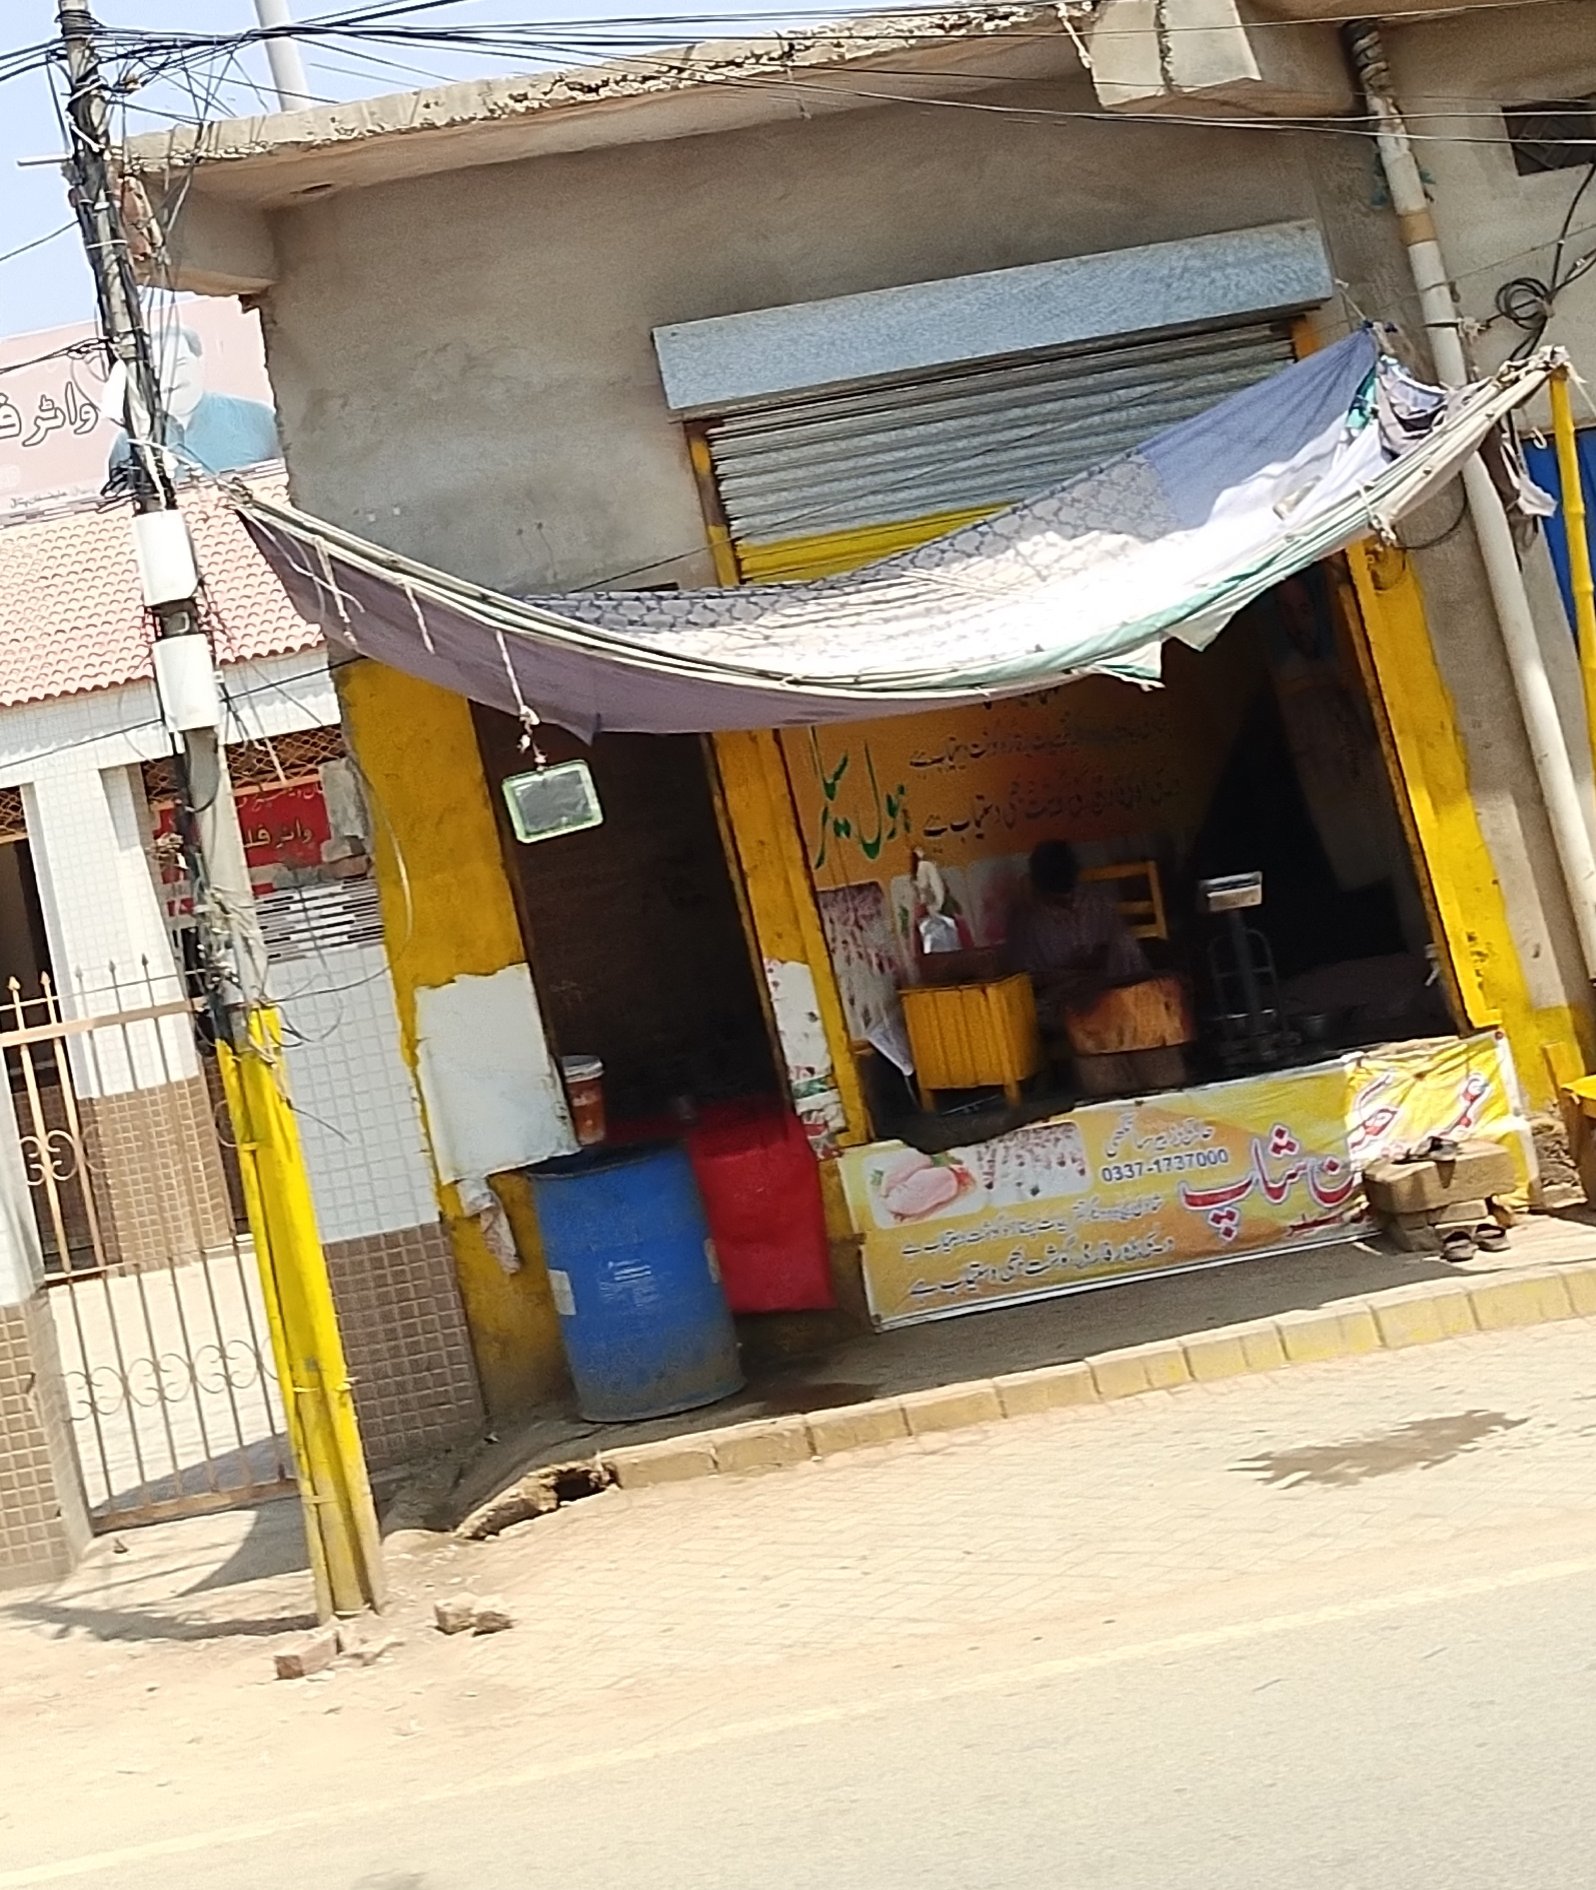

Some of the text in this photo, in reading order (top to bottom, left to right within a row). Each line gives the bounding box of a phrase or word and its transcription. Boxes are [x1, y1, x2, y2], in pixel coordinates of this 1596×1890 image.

[22, 381, 99, 447] واٹر
[1100, 1148, 1229, 1183] 0337-1737000
[1181, 1122, 1309, 1243] شاپ
